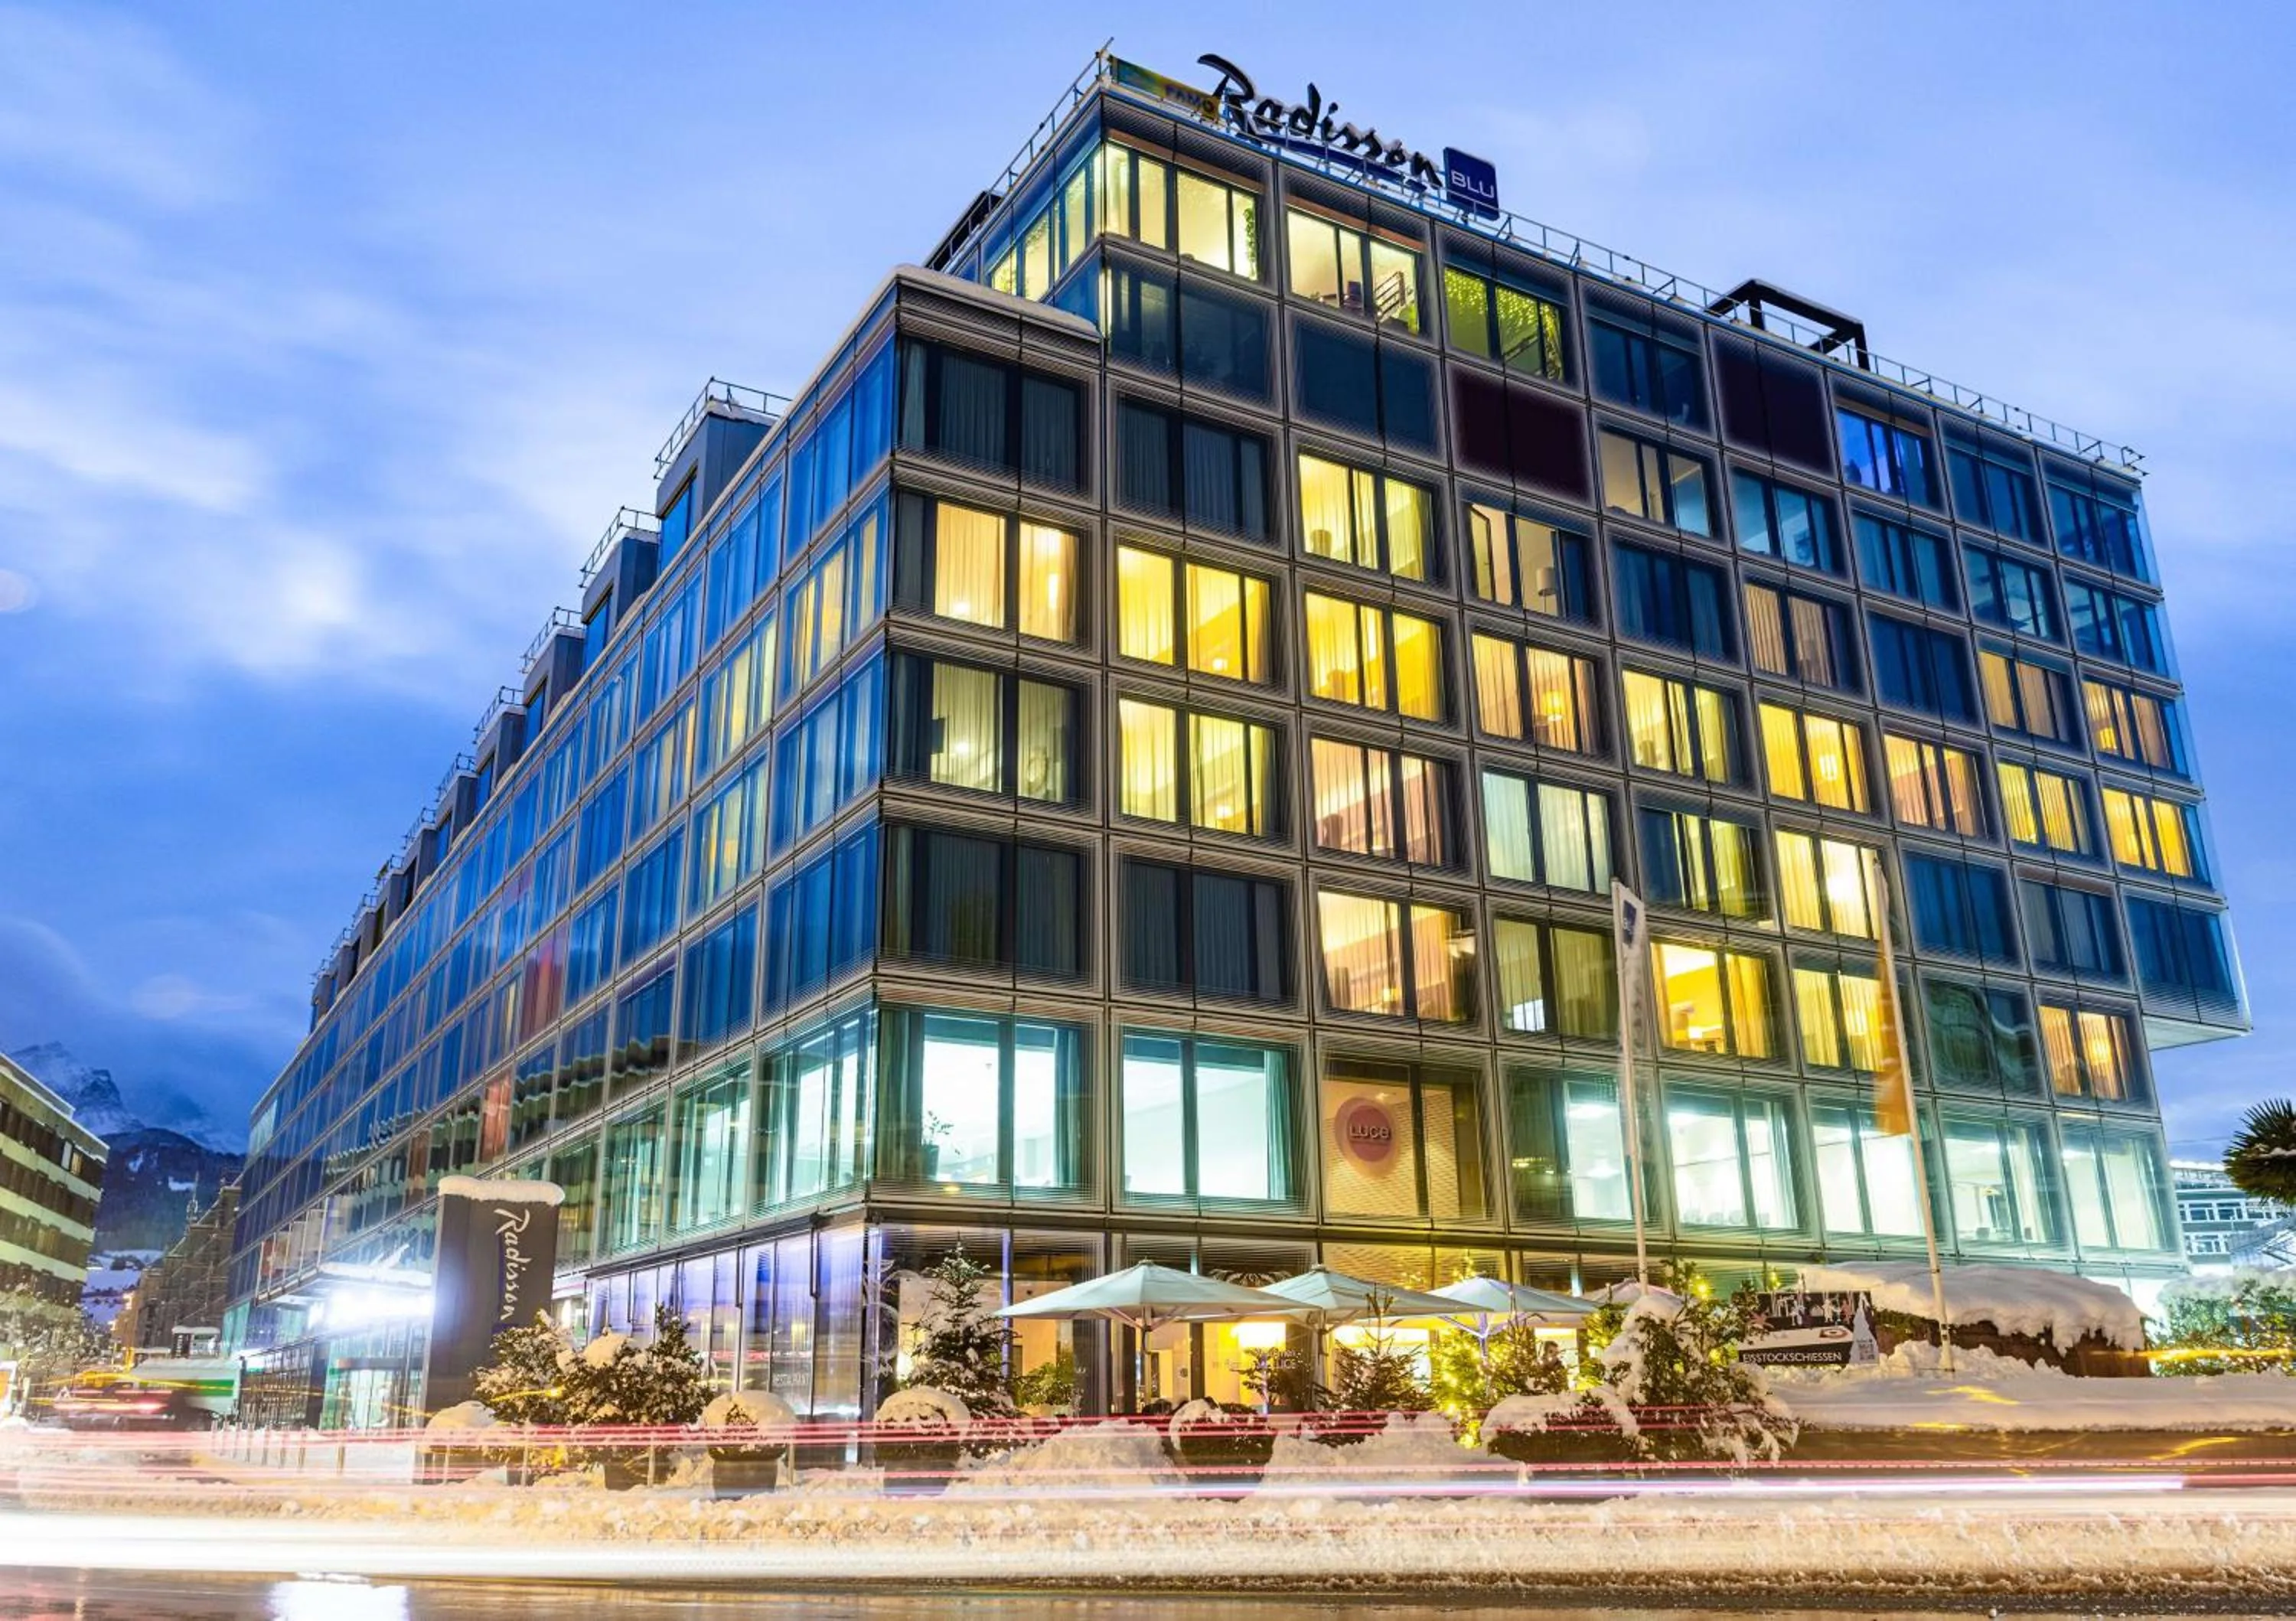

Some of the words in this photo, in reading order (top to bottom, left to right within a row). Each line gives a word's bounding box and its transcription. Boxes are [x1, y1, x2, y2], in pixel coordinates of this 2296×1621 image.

[1197, 53, 1443, 187] Radisson
[1450, 169, 1495, 198] BLU
[494, 1208, 531, 1320] Radisson
[1743, 1351, 1842, 1363] EISSTOCKSCHIESSEN
